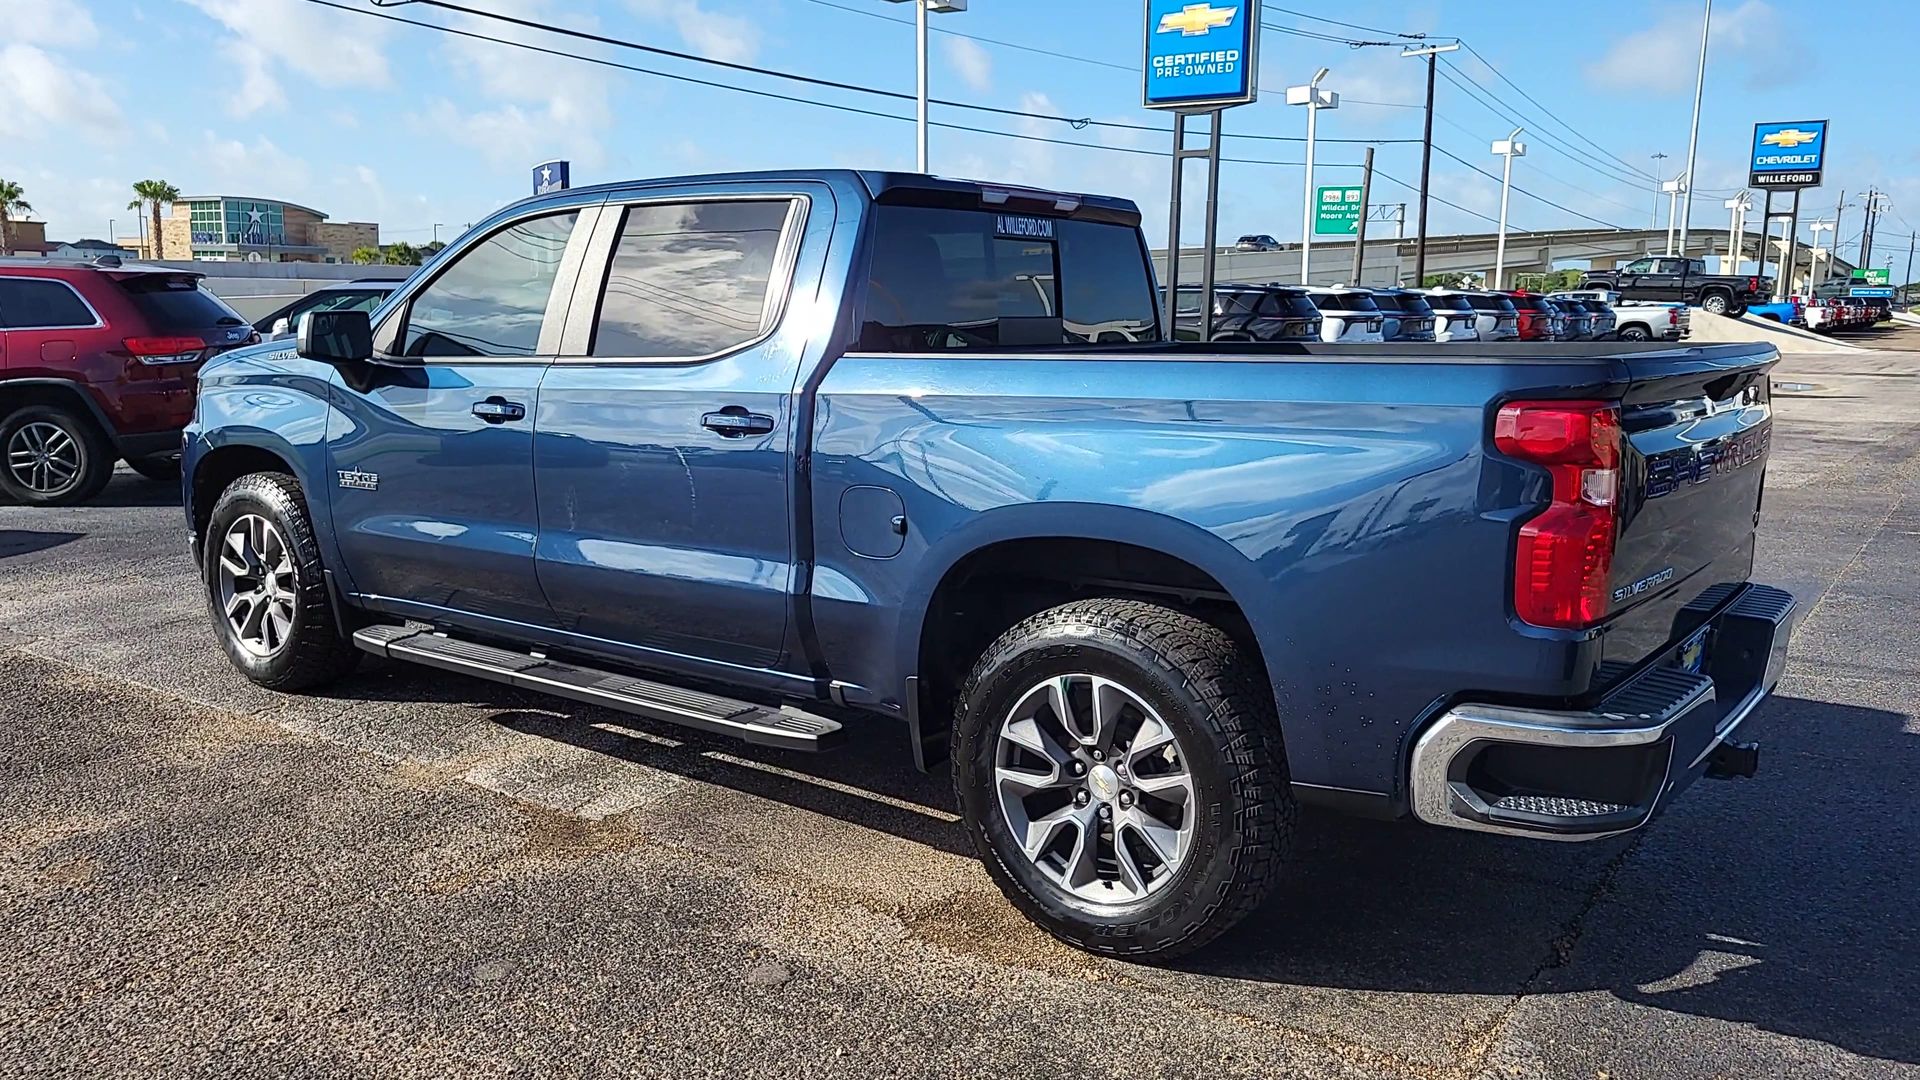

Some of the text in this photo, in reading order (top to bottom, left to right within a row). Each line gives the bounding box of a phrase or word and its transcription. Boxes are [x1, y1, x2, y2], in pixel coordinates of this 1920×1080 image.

[1152, 50, 1239, 68] CERTIFIED
[1156, 62, 1234, 78] PRE-OWNED
[1756, 154, 1817, 165] CHEVROLET
[1757, 174, 1813, 183] WILLEFORD
[1613, 567, 1673, 602] SILVERADO
